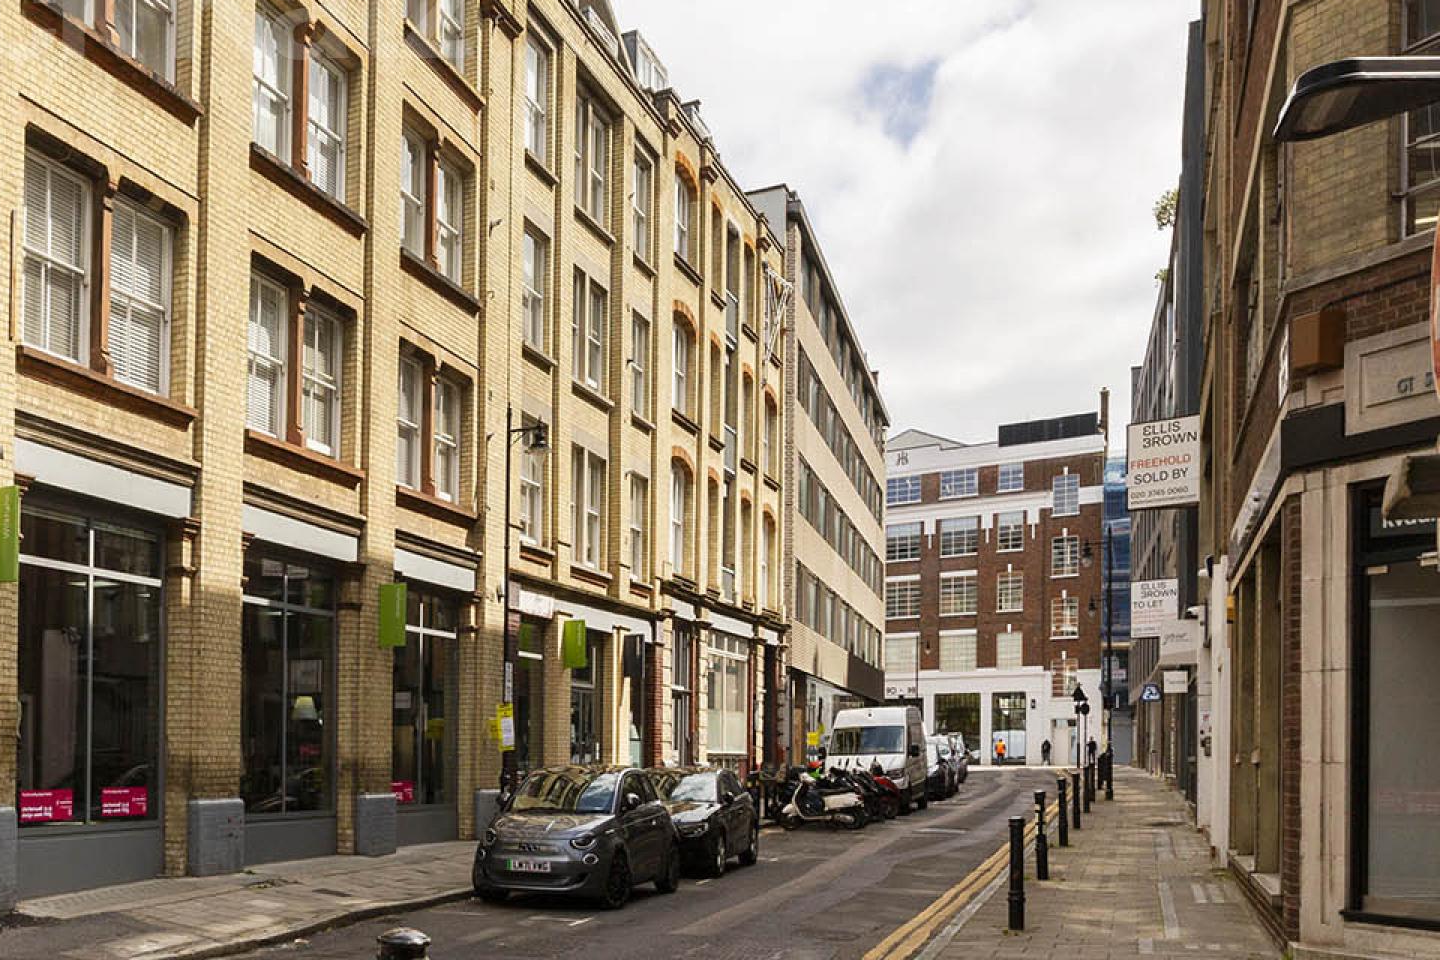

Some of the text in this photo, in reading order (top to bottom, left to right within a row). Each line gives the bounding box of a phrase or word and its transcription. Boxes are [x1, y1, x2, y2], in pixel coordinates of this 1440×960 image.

[1143, 422, 1181, 436] ELLIS
[1143, 431, 1197, 448] BROWN
[1131, 454, 1191, 470] FREEHOLD
[1134, 467, 1189, 485] SOLD BY
